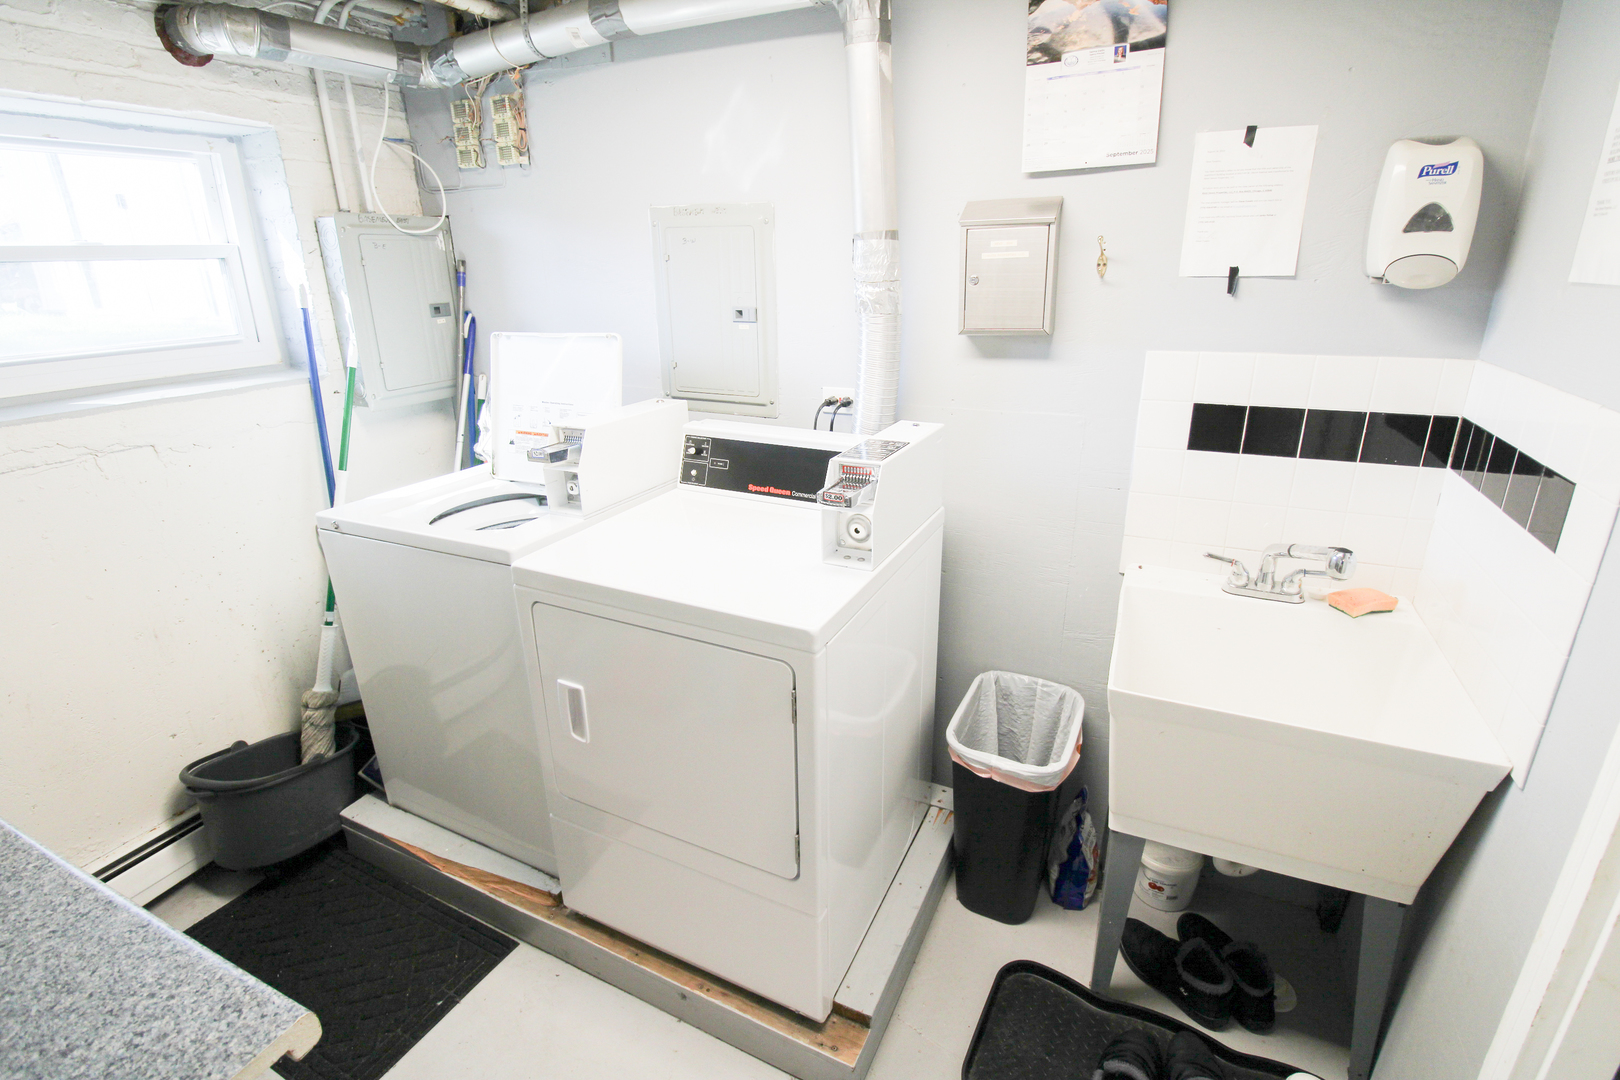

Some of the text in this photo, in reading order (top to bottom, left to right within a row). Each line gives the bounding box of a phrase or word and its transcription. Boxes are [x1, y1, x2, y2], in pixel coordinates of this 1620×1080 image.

[1421, 164, 1455, 176] Purell
[747, 483, 769, 493] Speed
[769, 487, 791, 496] Queen
[824, 493, 843, 501] $2.00
